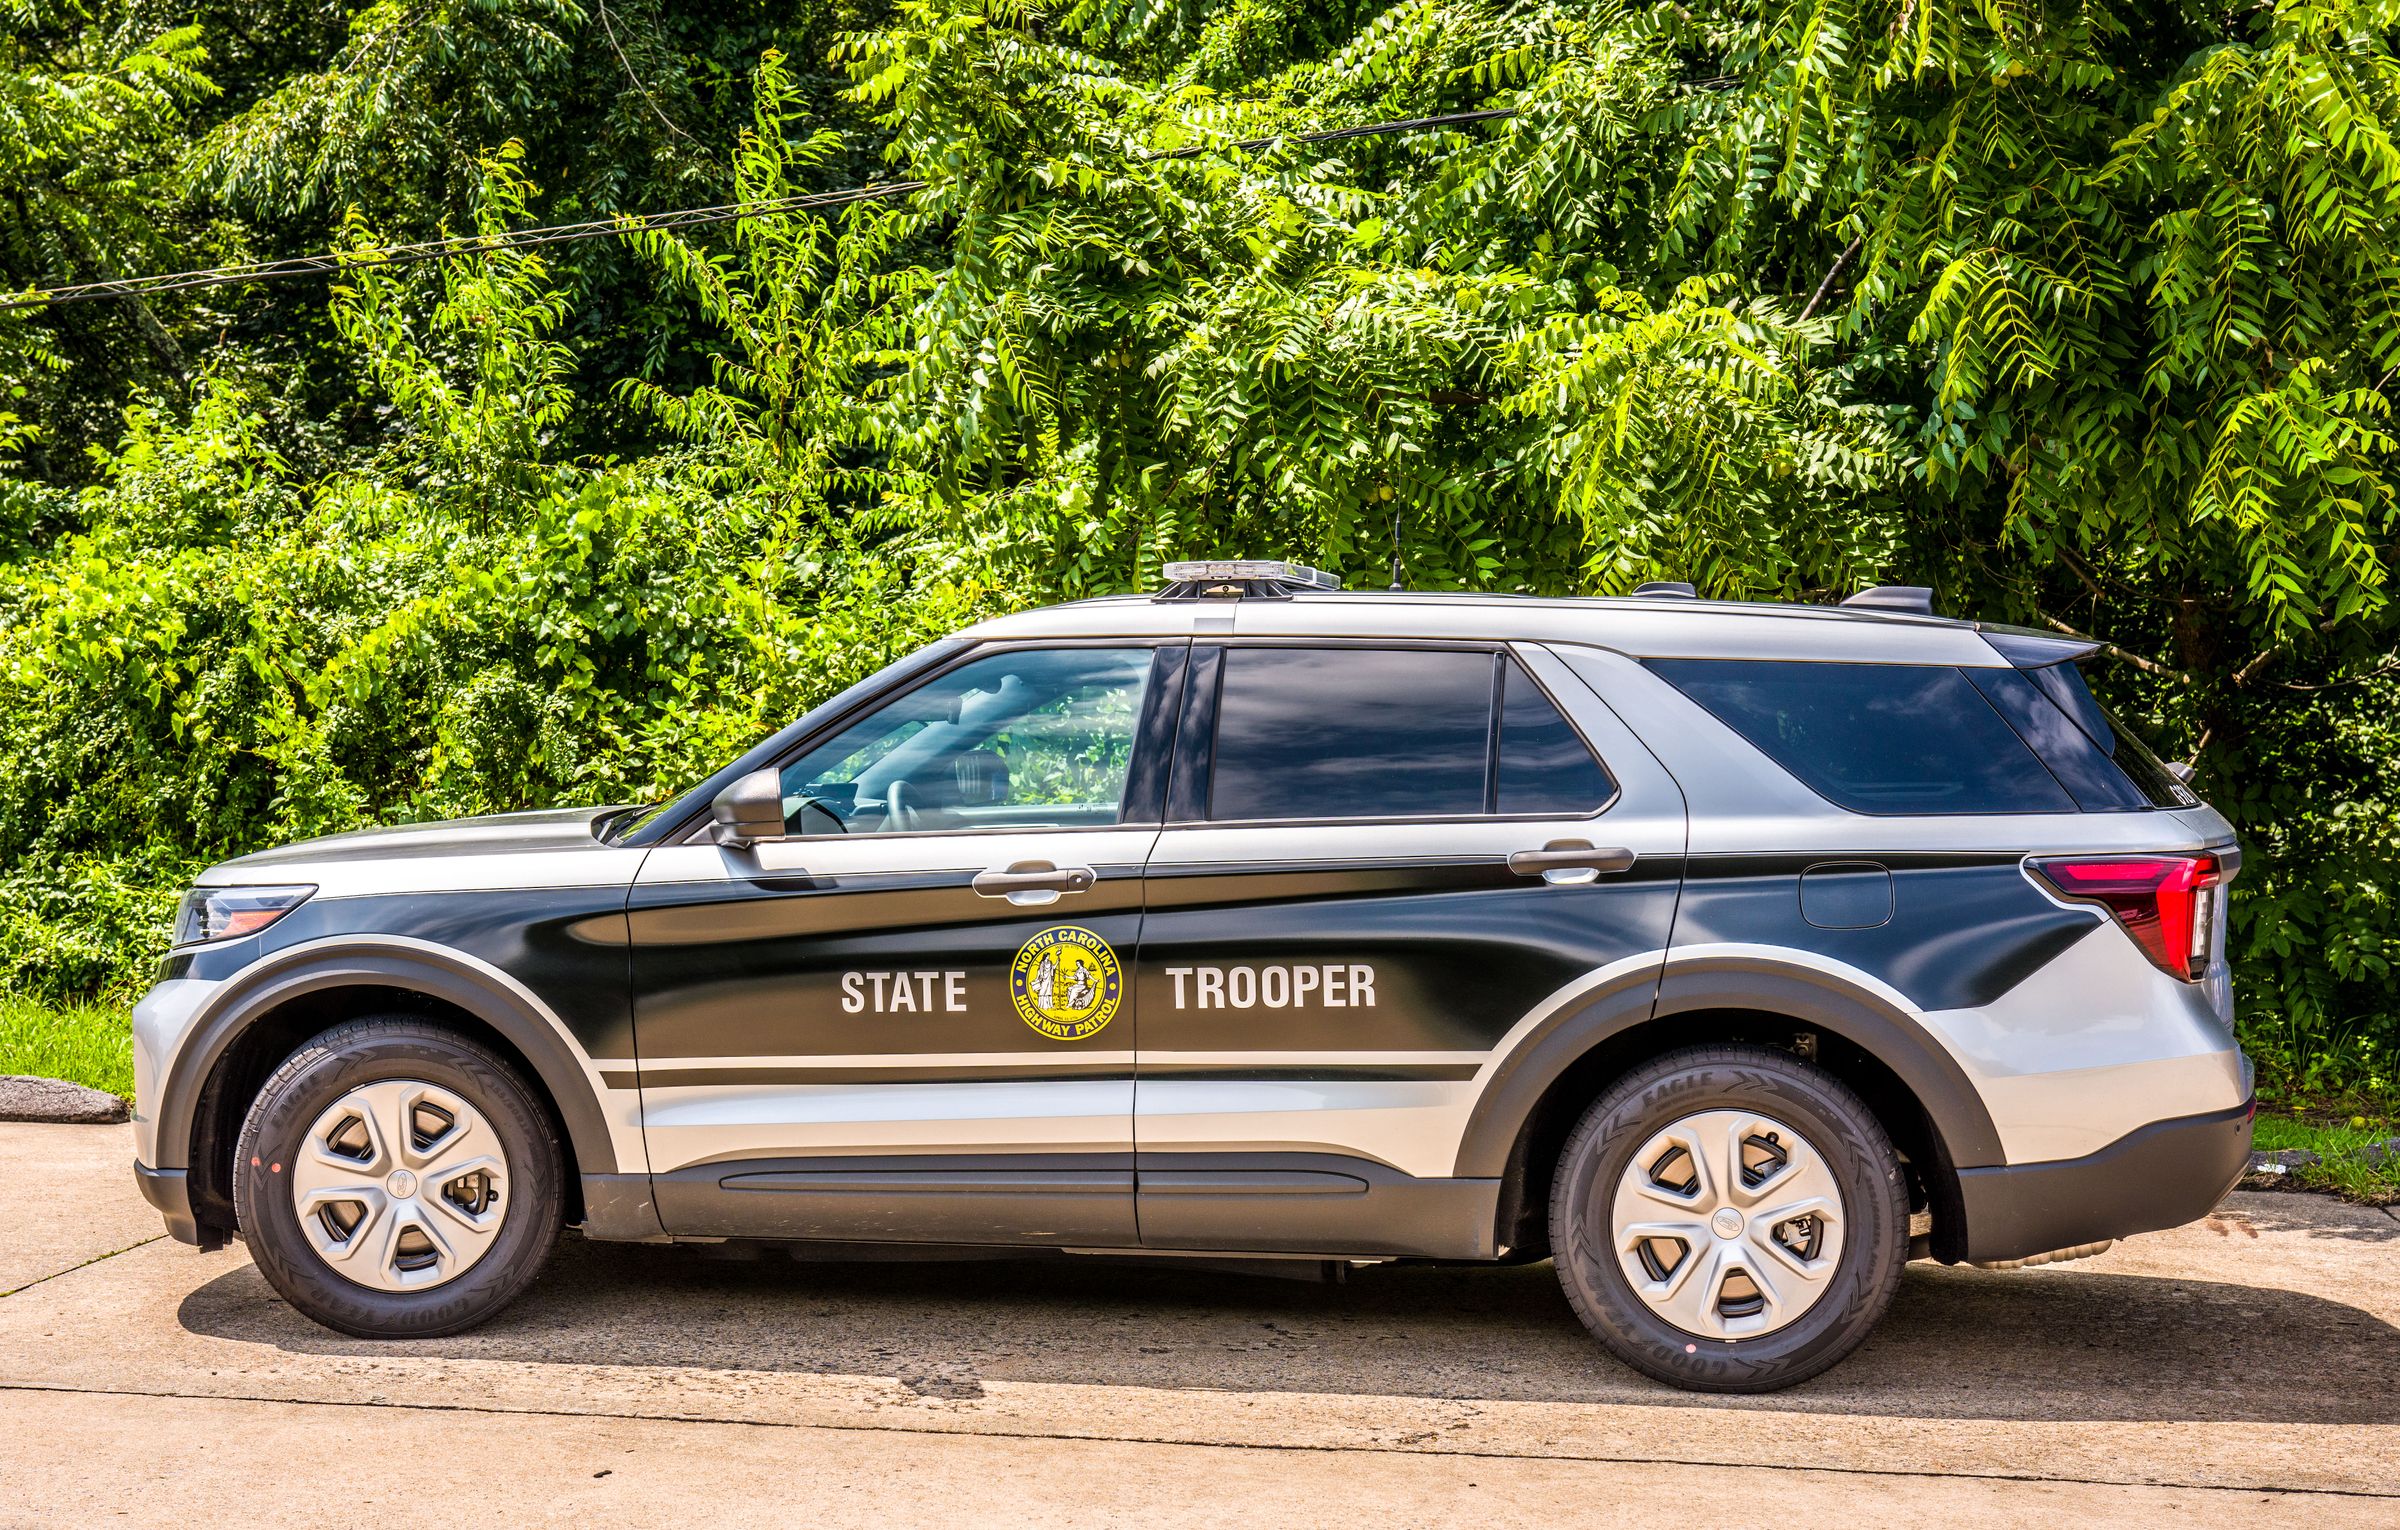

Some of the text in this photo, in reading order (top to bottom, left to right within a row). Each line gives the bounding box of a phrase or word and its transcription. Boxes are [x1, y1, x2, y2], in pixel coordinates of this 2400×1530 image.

[1016, 930, 1117, 977] NORTH CAROLINA
[841, 964, 1377, 1013] STATE TROOPER
[1016, 993, 1117, 1036] HIGHWAY PATROL
[1642, 1071, 1714, 1108] EAGLE
